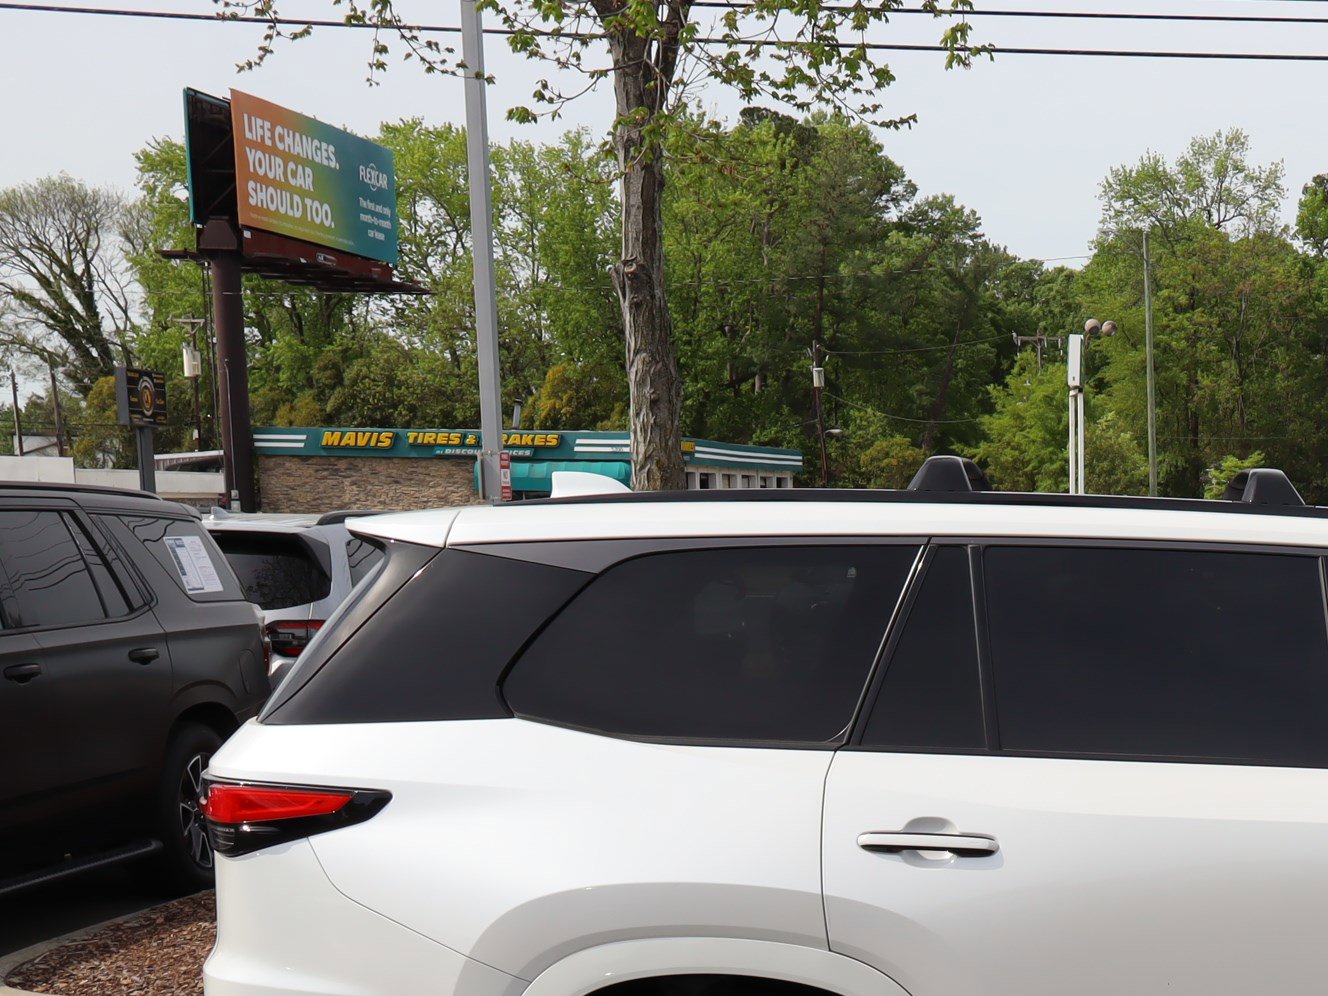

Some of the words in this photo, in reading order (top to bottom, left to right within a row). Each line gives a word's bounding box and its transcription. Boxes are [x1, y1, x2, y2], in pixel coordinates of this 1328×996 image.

[244, 113, 272, 146] LIFE
[275, 125, 340, 170] CHANGES.
[245, 147, 284, 183] YOUR
[287, 161, 314, 192] CAR
[359, 164, 388, 190] FLEXCAR
[247, 180, 303, 218] SHOULD
[305, 198, 335, 229] TOO.
[321, 431, 394, 447] MAVIS
[407, 432, 462, 445] TIRES
[466, 434, 477, 445] &
[502, 433, 559, 446] RAKES
